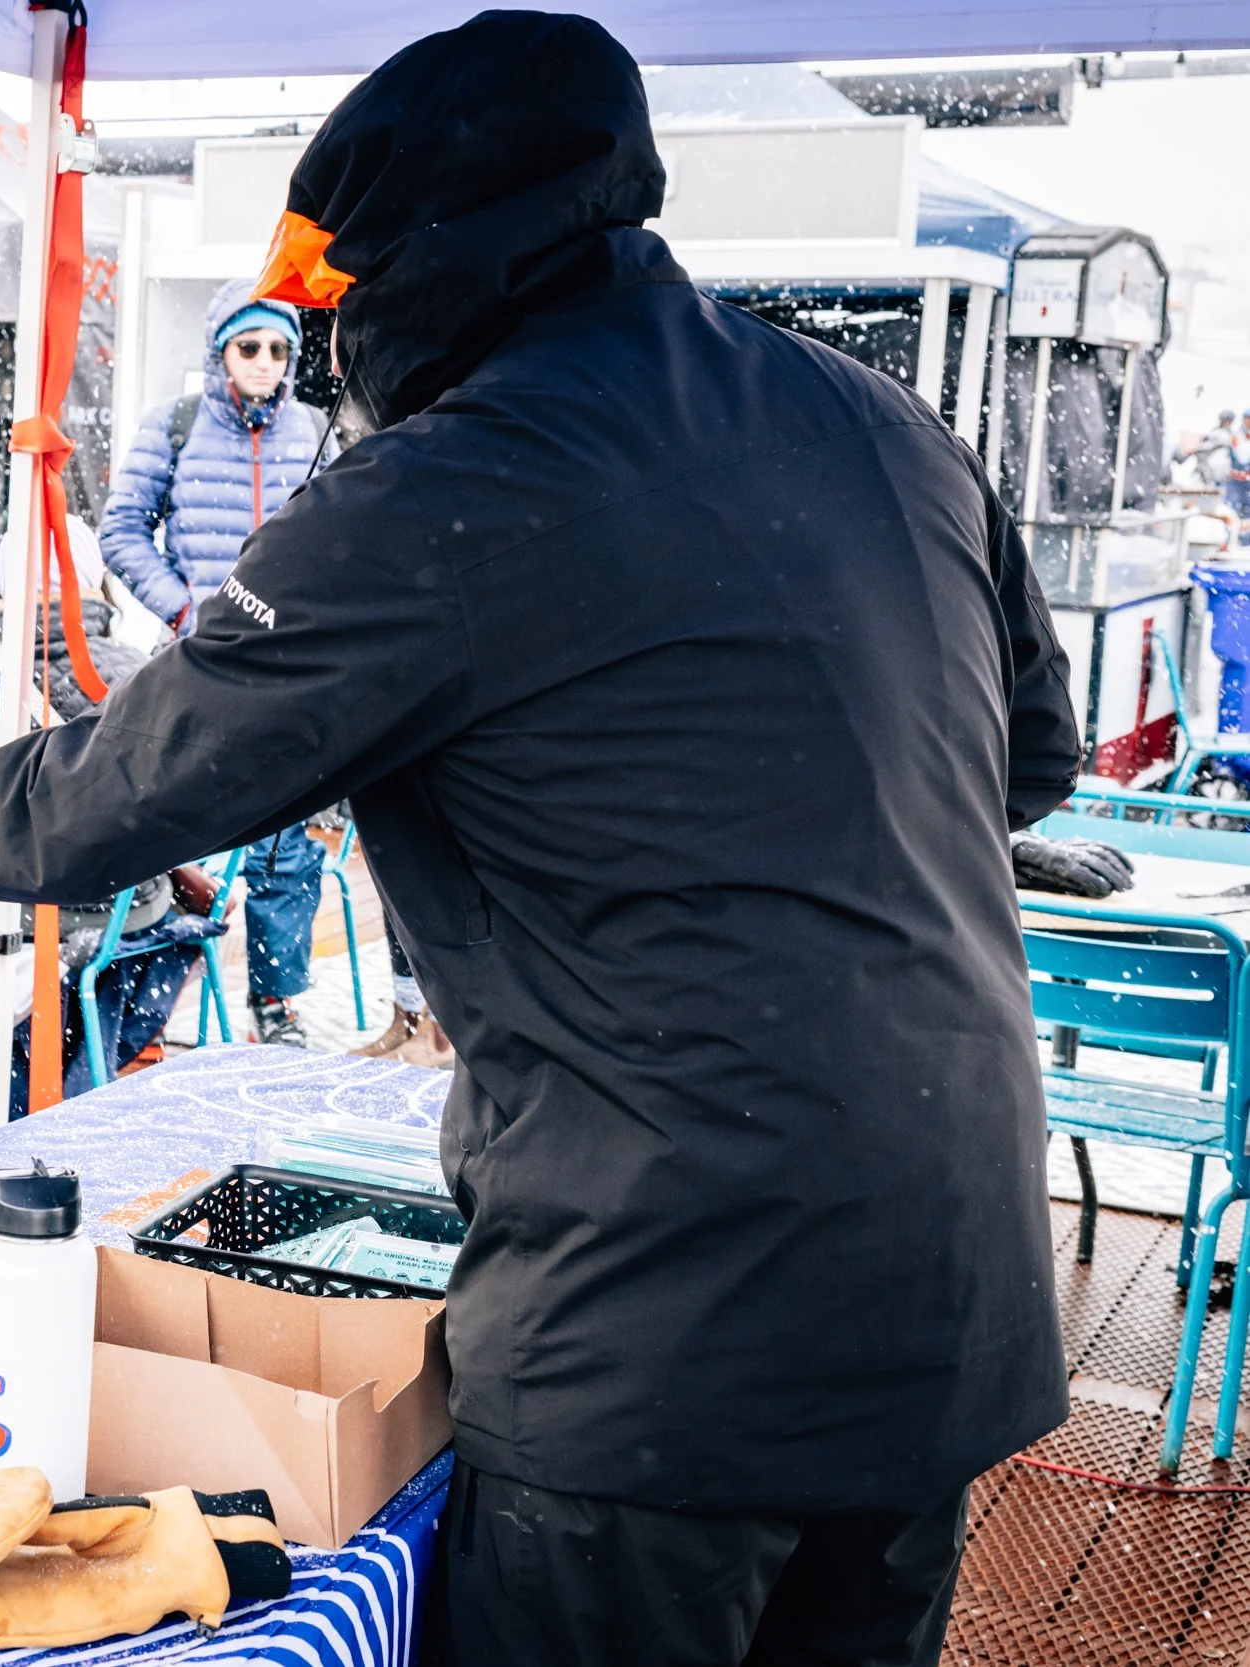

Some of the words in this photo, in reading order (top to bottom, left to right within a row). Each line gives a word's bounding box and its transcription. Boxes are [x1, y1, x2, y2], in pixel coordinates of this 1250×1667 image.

[223, 575, 276, 630] TOYOTA
[384, 1252, 420, 1263] ORIGINAL
[396, 1260, 437, 1271] SEAMLESS
